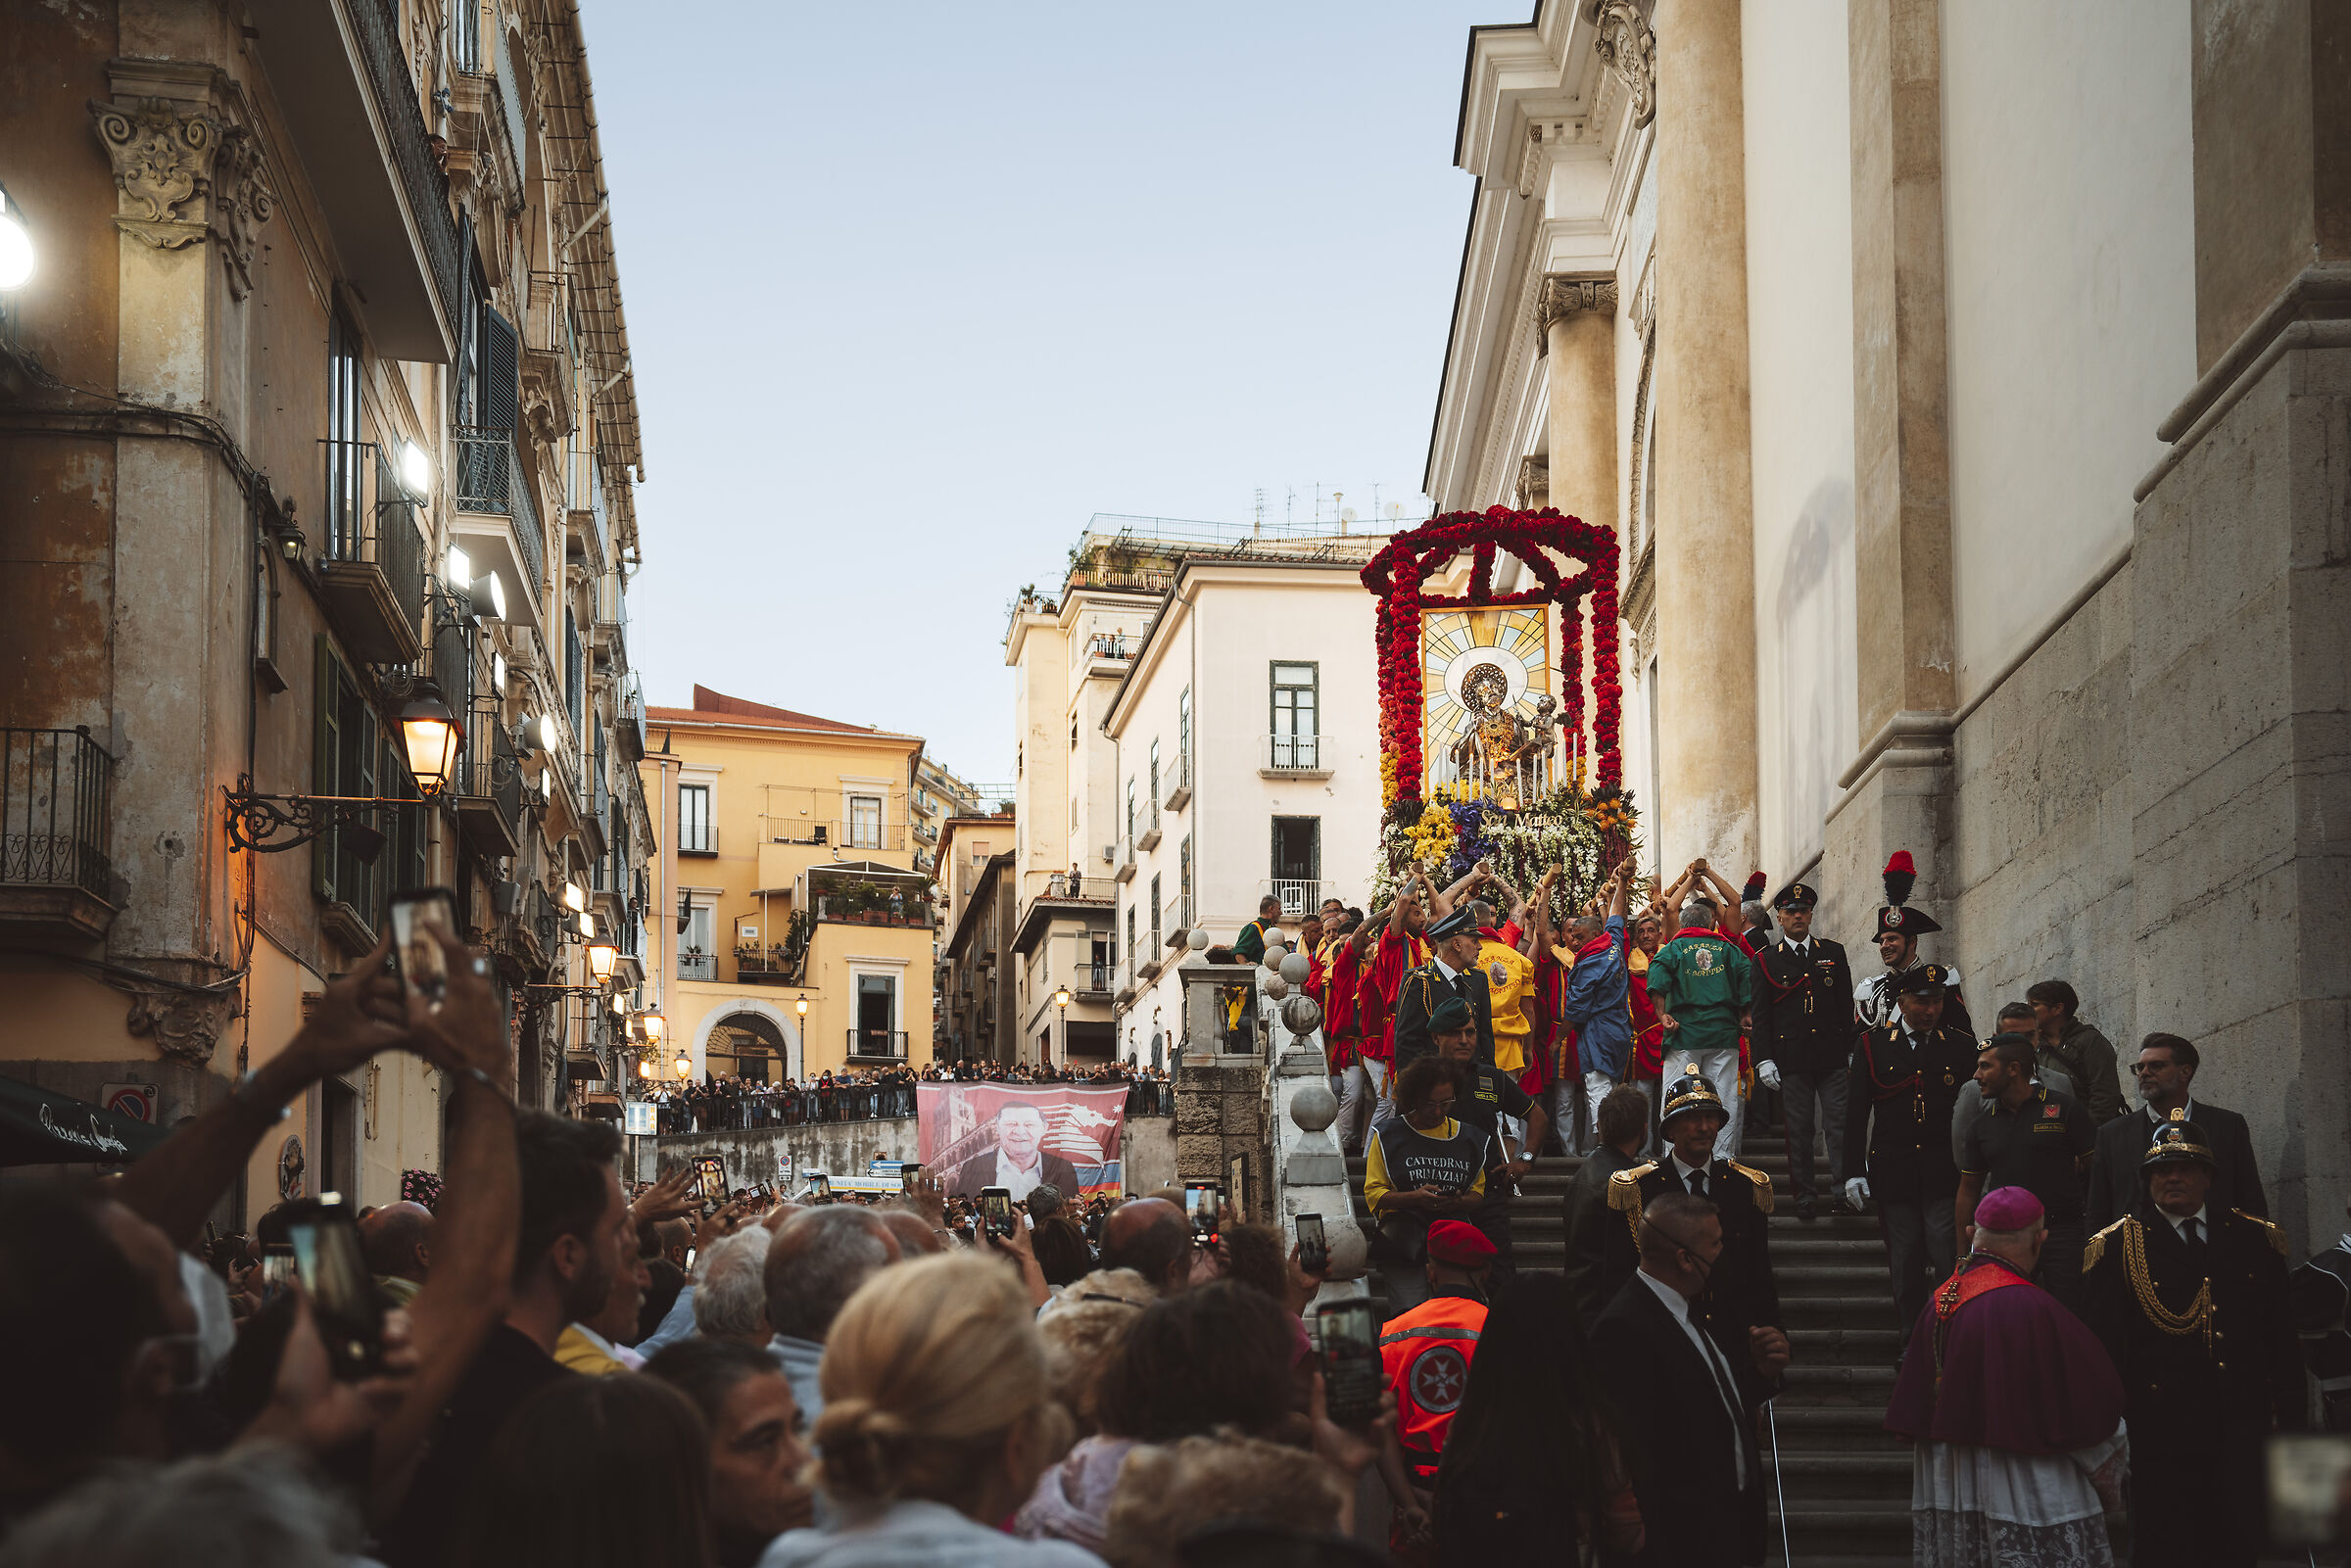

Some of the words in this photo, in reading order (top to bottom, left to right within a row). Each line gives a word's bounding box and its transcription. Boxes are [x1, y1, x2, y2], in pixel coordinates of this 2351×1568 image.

[1479, 809, 1508, 827] San
[1514, 812, 1563, 828] Matteo
[1405, 1157, 1470, 1171] CATTEDRALE
